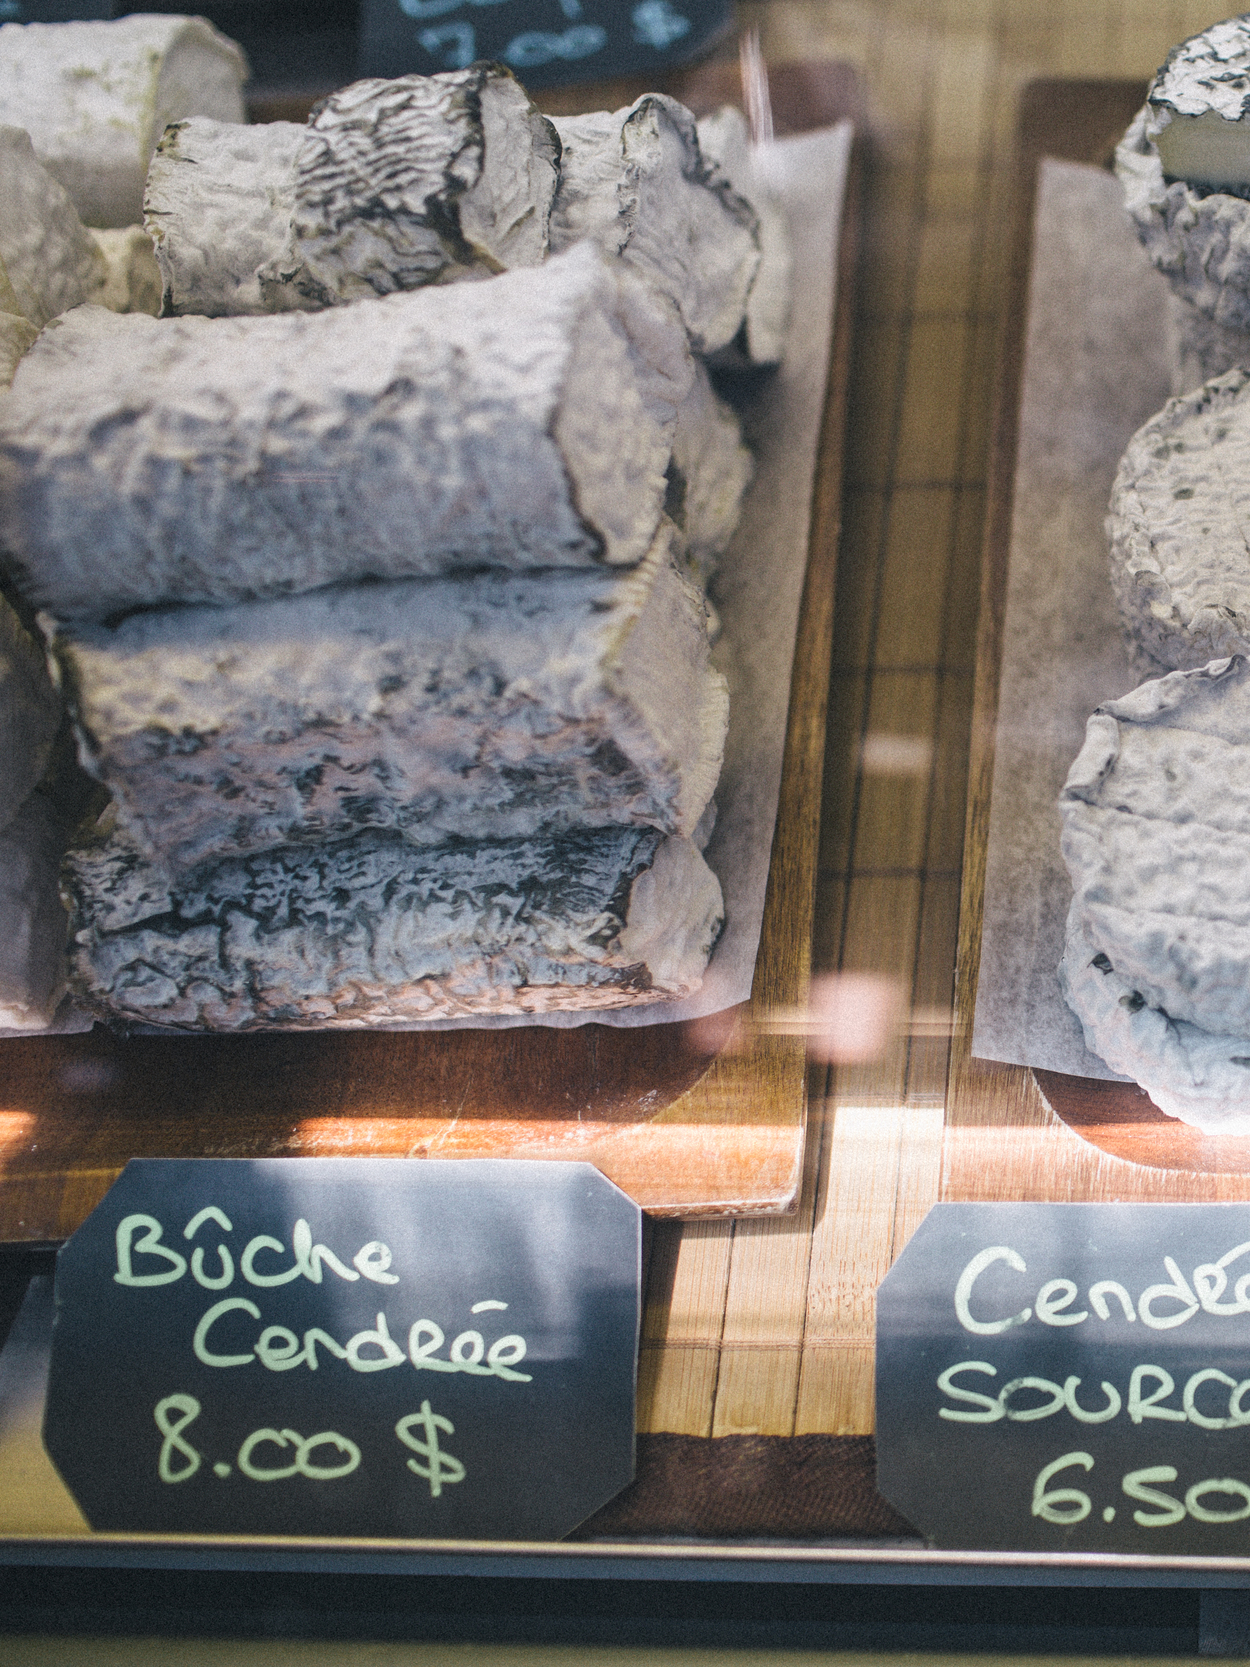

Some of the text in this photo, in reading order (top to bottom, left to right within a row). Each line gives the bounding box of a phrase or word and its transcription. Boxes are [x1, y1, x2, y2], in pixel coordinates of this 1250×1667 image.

[114, 1206, 400, 1290] Bûche
[154, 1394, 466, 1498] 8.00 $
